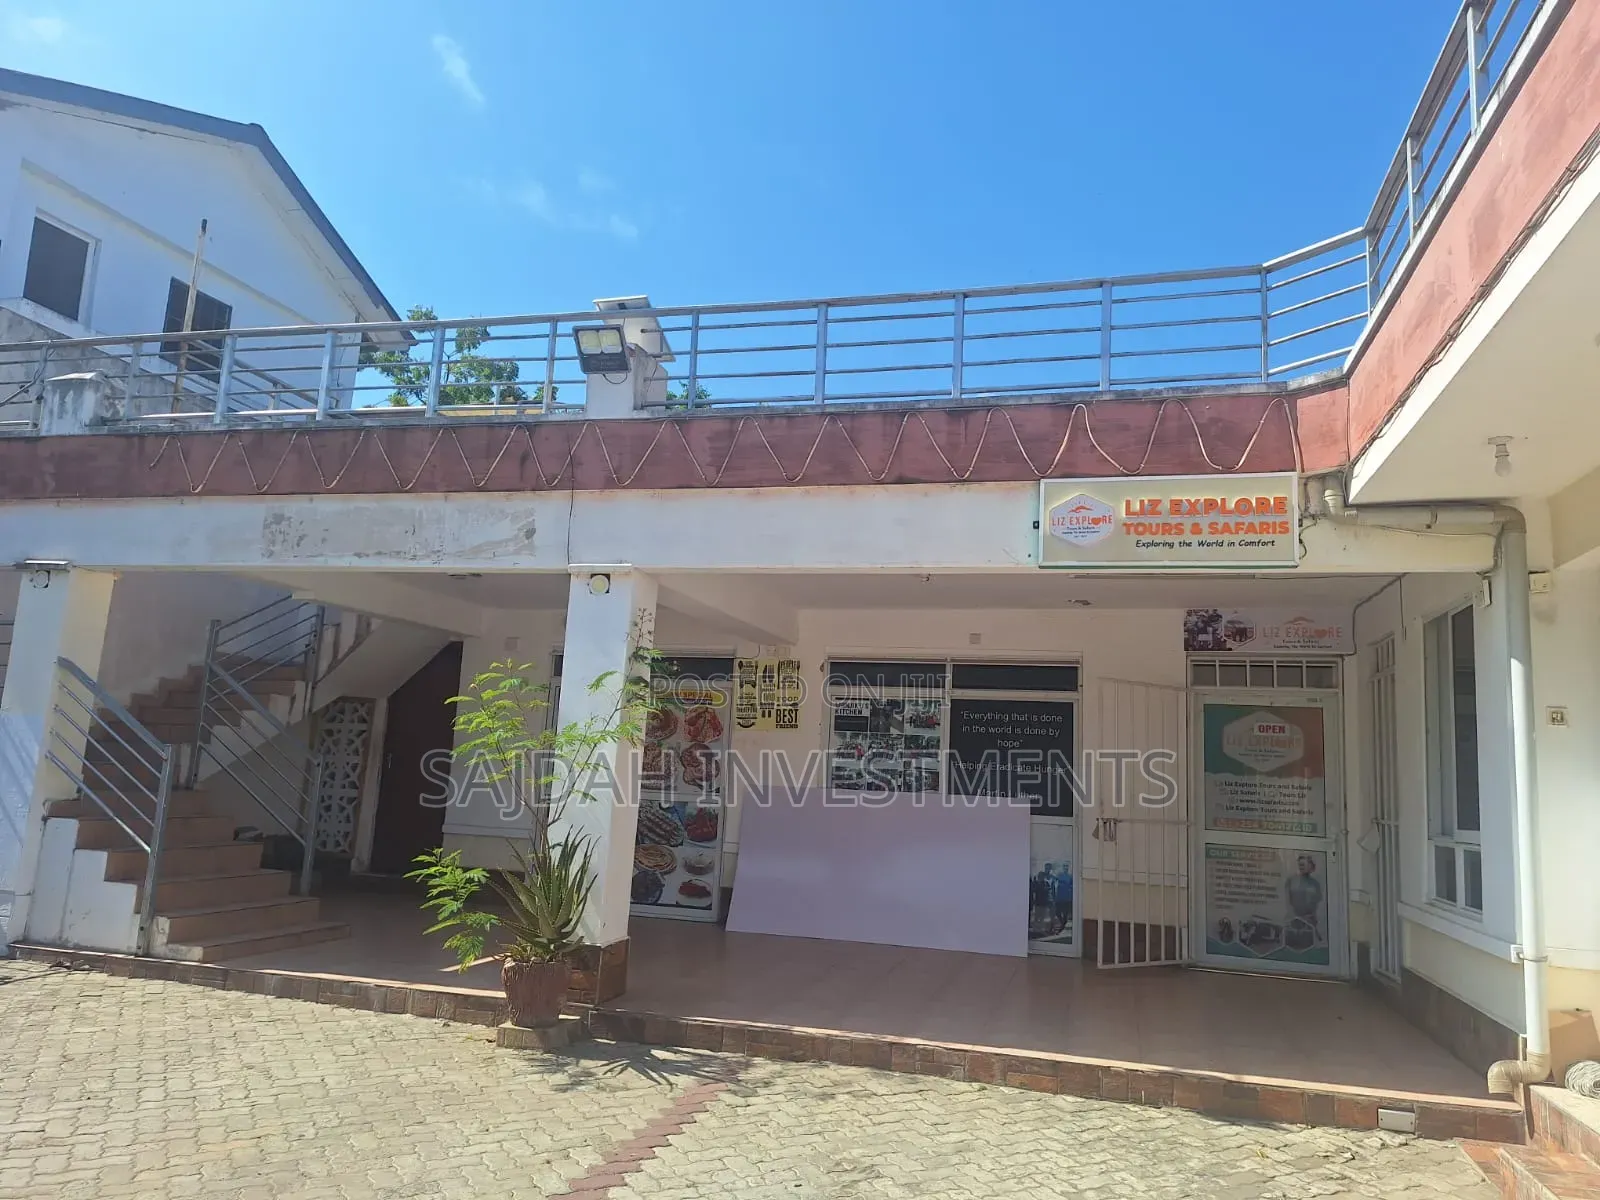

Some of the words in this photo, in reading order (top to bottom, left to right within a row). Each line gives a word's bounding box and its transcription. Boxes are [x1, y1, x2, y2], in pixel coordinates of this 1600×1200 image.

[1124, 498, 1163, 517] LIZ
[1169, 496, 1288, 517] EXPLORE
[1052, 516, 1066, 526] LIZ
[1123, 523, 1185, 536] TOURS
[1190, 522, 1203, 536] &
[1208, 521, 1290, 535] SAFARIS
[1135, 539, 1175, 549] Exploring
[1178, 539, 1193, 547] the
[1197, 539, 1224, 547] World
[1227, 539, 1236, 547] in
[1238, 539, 1276, 548] Comfort
[1263, 627, 1280, 638] LIZ
[775, 708, 799, 723] BEST
[1011, 711, 1028, 721] that
[1030, 712, 1038, 721] is
[1040, 712, 1063, 722] done
[962, 724, 970, 732] in
[972, 724, 986, 732] the
[988, 726, 1012, 734] world
[1015, 726, 1022, 734] is
[1024, 726, 1047, 735] done
[1049, 727, 1060, 737] by
[1258, 724, 1286, 734] OPEN
[977, 789, 1006, 798] Martin
